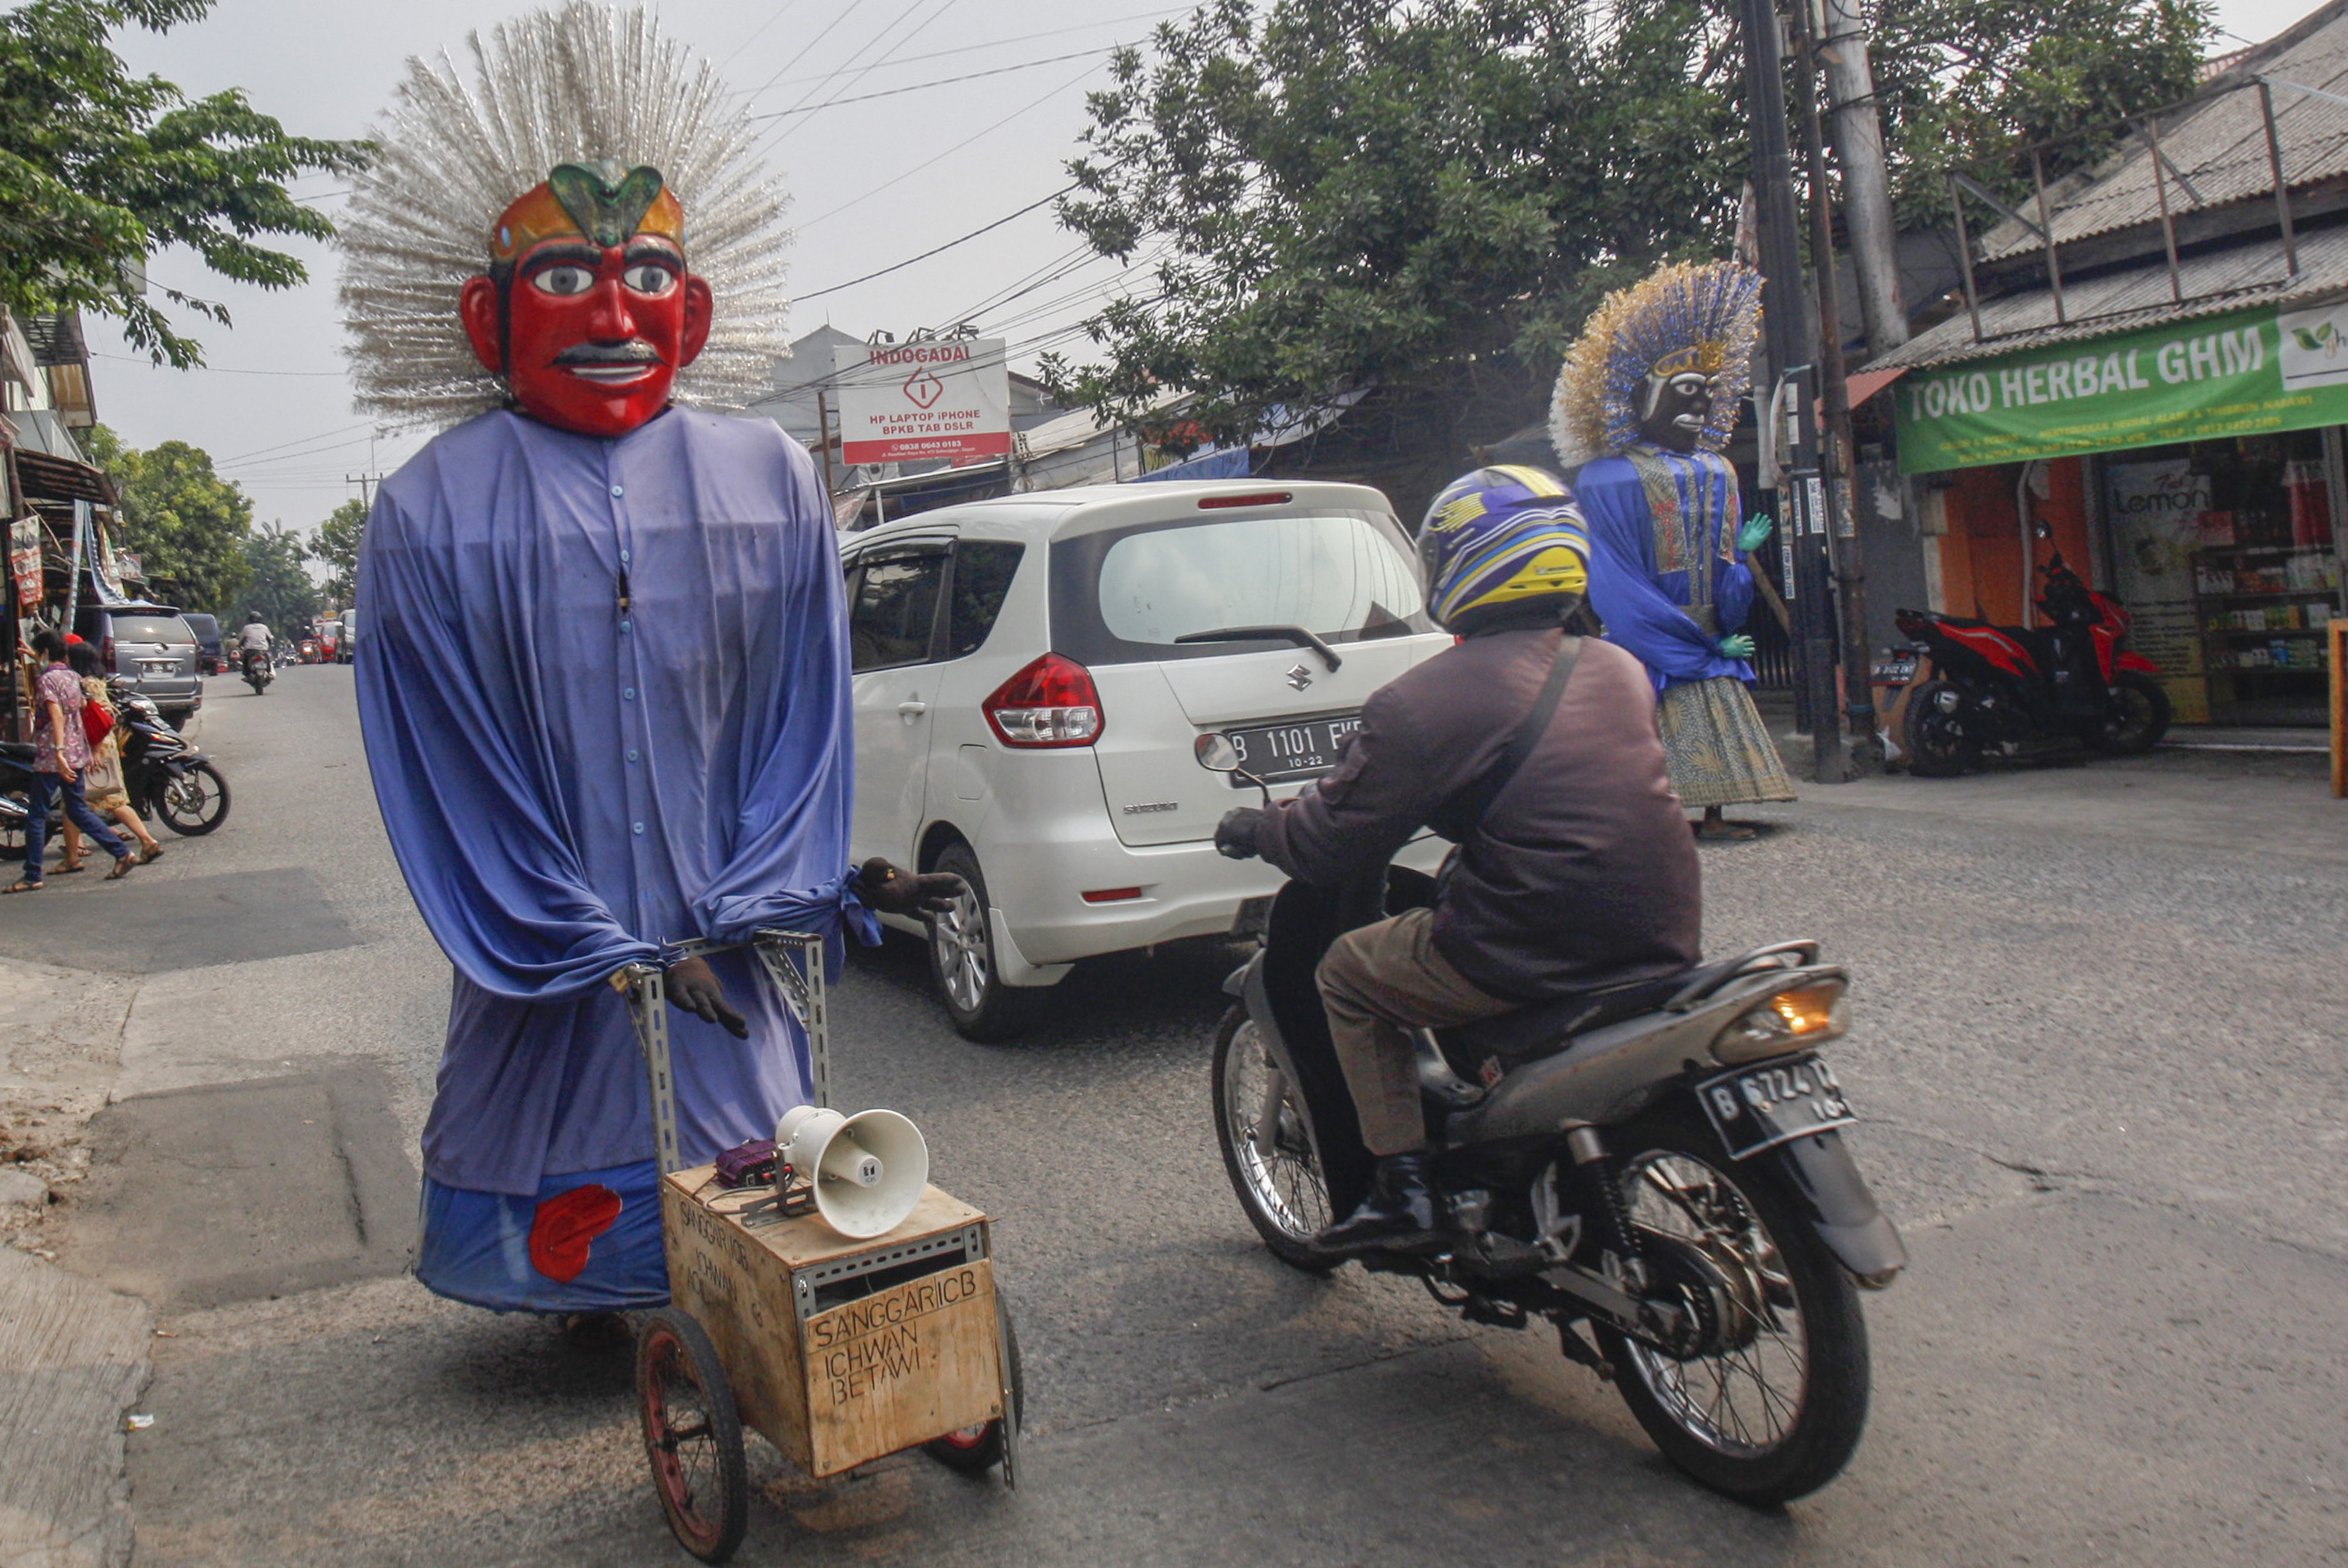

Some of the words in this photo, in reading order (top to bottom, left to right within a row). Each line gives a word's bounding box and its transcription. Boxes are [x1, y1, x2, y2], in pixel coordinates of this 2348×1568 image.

[870, 346, 970, 366] INDOGADAI
[2325, 328, 2347, 359] gh
[1910, 373, 1991, 420] TOKO
[1999, 353, 2150, 408] HERBAL
[2157, 326, 2264, 385] GHM
[870, 415, 885, 424] HP
[889, 413, 935, 423] LAPTOP
[883, 424, 914, 435] BPKB
[917, 423, 941, 433] TAB
[944, 421, 974, 431] DSLR
[2114, 488, 2209, 515] Lemon
[1233, 735, 1247, 762] B
[1267, 727, 1315, 758] 1101
[1123, 800, 1178, 815] SUZUKI
[1711, 1087, 1740, 1121] B
[815, 1284, 936, 1348] SANGGAR
[937, 1269, 977, 1309] ICB
[824, 1321, 919, 1380] ICHWAN
[831, 1346, 921, 1405] BETAWI
